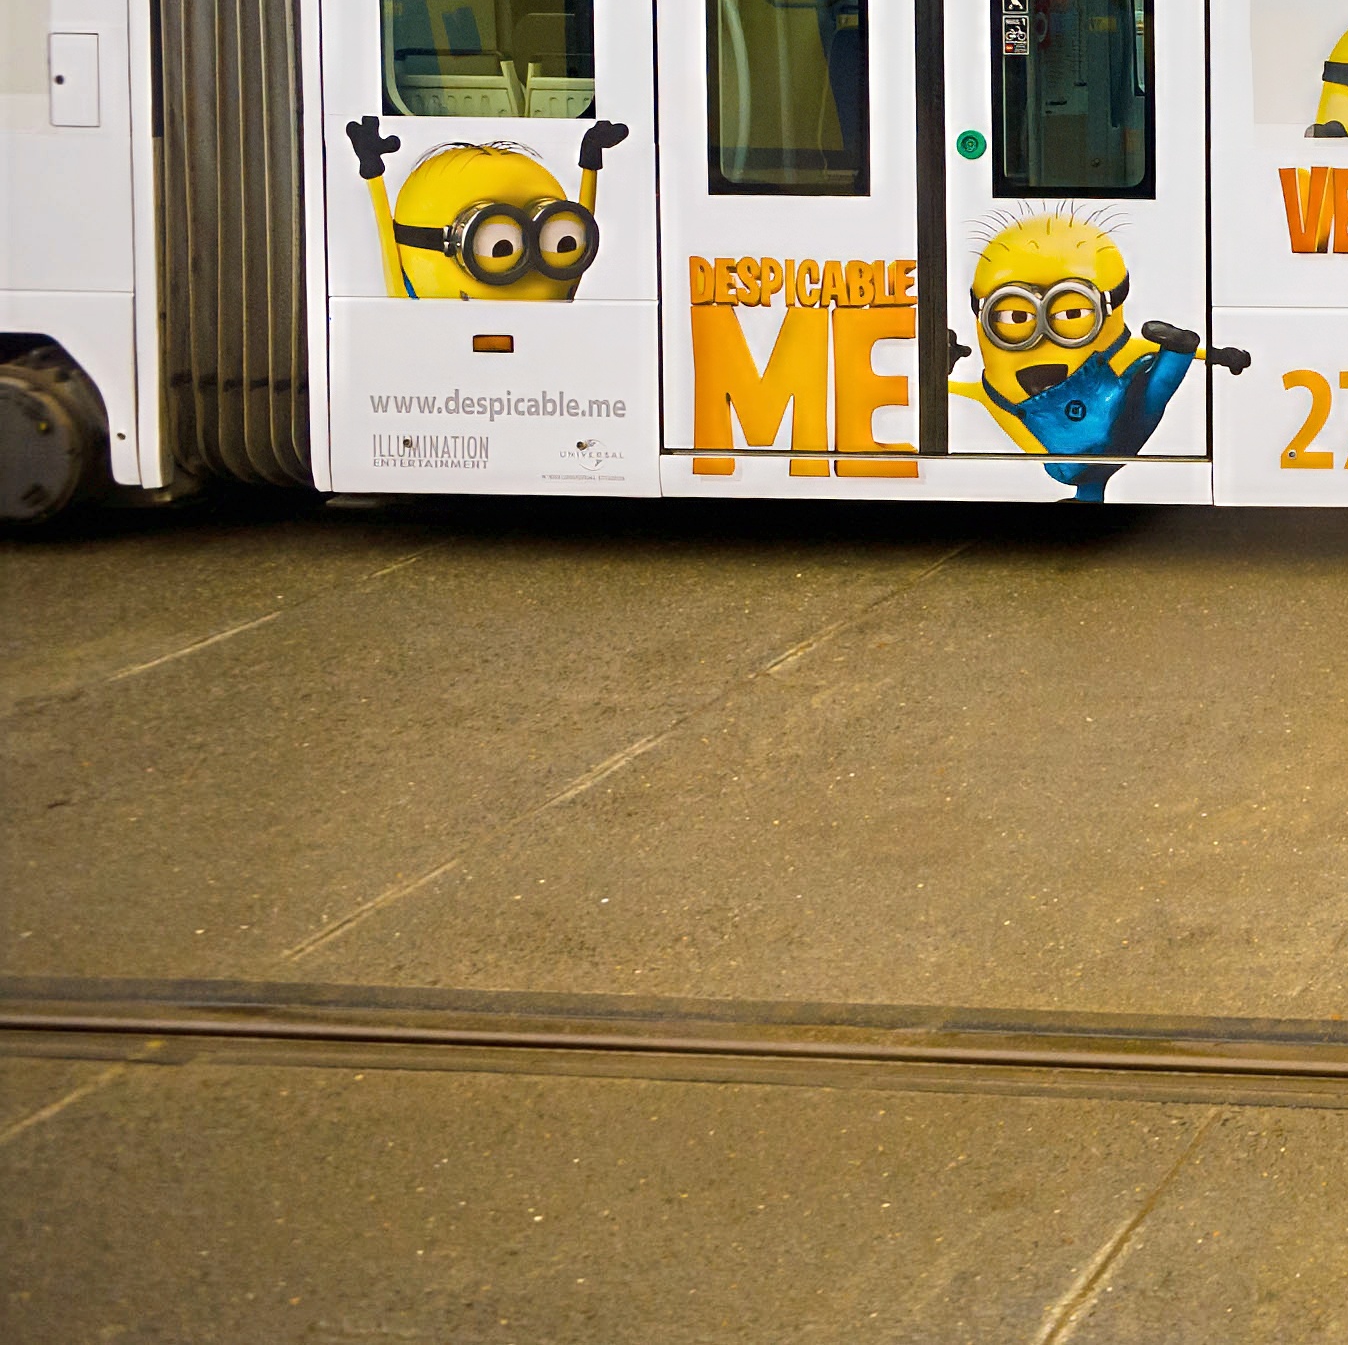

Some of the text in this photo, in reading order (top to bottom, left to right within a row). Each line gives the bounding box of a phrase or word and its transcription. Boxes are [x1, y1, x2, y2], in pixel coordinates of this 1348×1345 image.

[689, 255, 917, 307] DESPICABLE
[369, 388, 627, 422] www.despicable.me
[690, 304, 919, 478] ME
[372, 433, 490, 460] ILLUMINATION
[372, 457, 490, 470] ENTERTAINMENT
